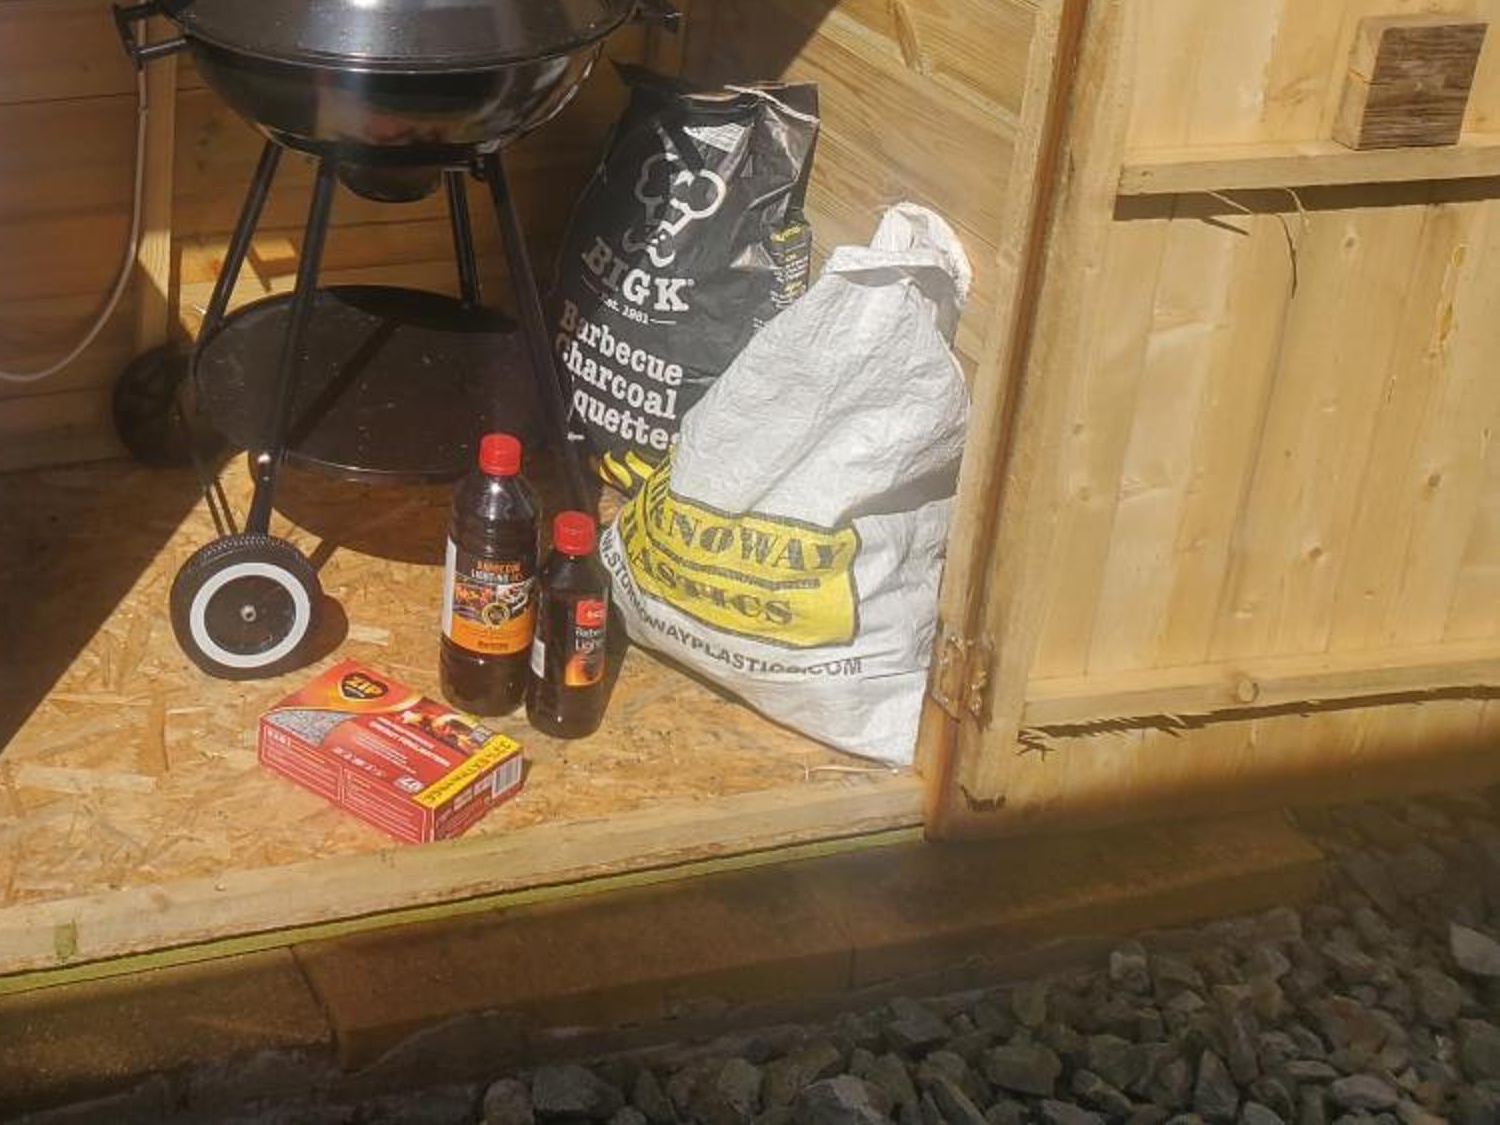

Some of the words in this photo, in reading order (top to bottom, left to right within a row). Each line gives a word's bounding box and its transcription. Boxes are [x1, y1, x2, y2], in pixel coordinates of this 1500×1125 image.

[554, 332, 677, 421] Charcoal
[558, 298, 684, 387] Barbecue
[344, 673, 384, 696] ZIP
